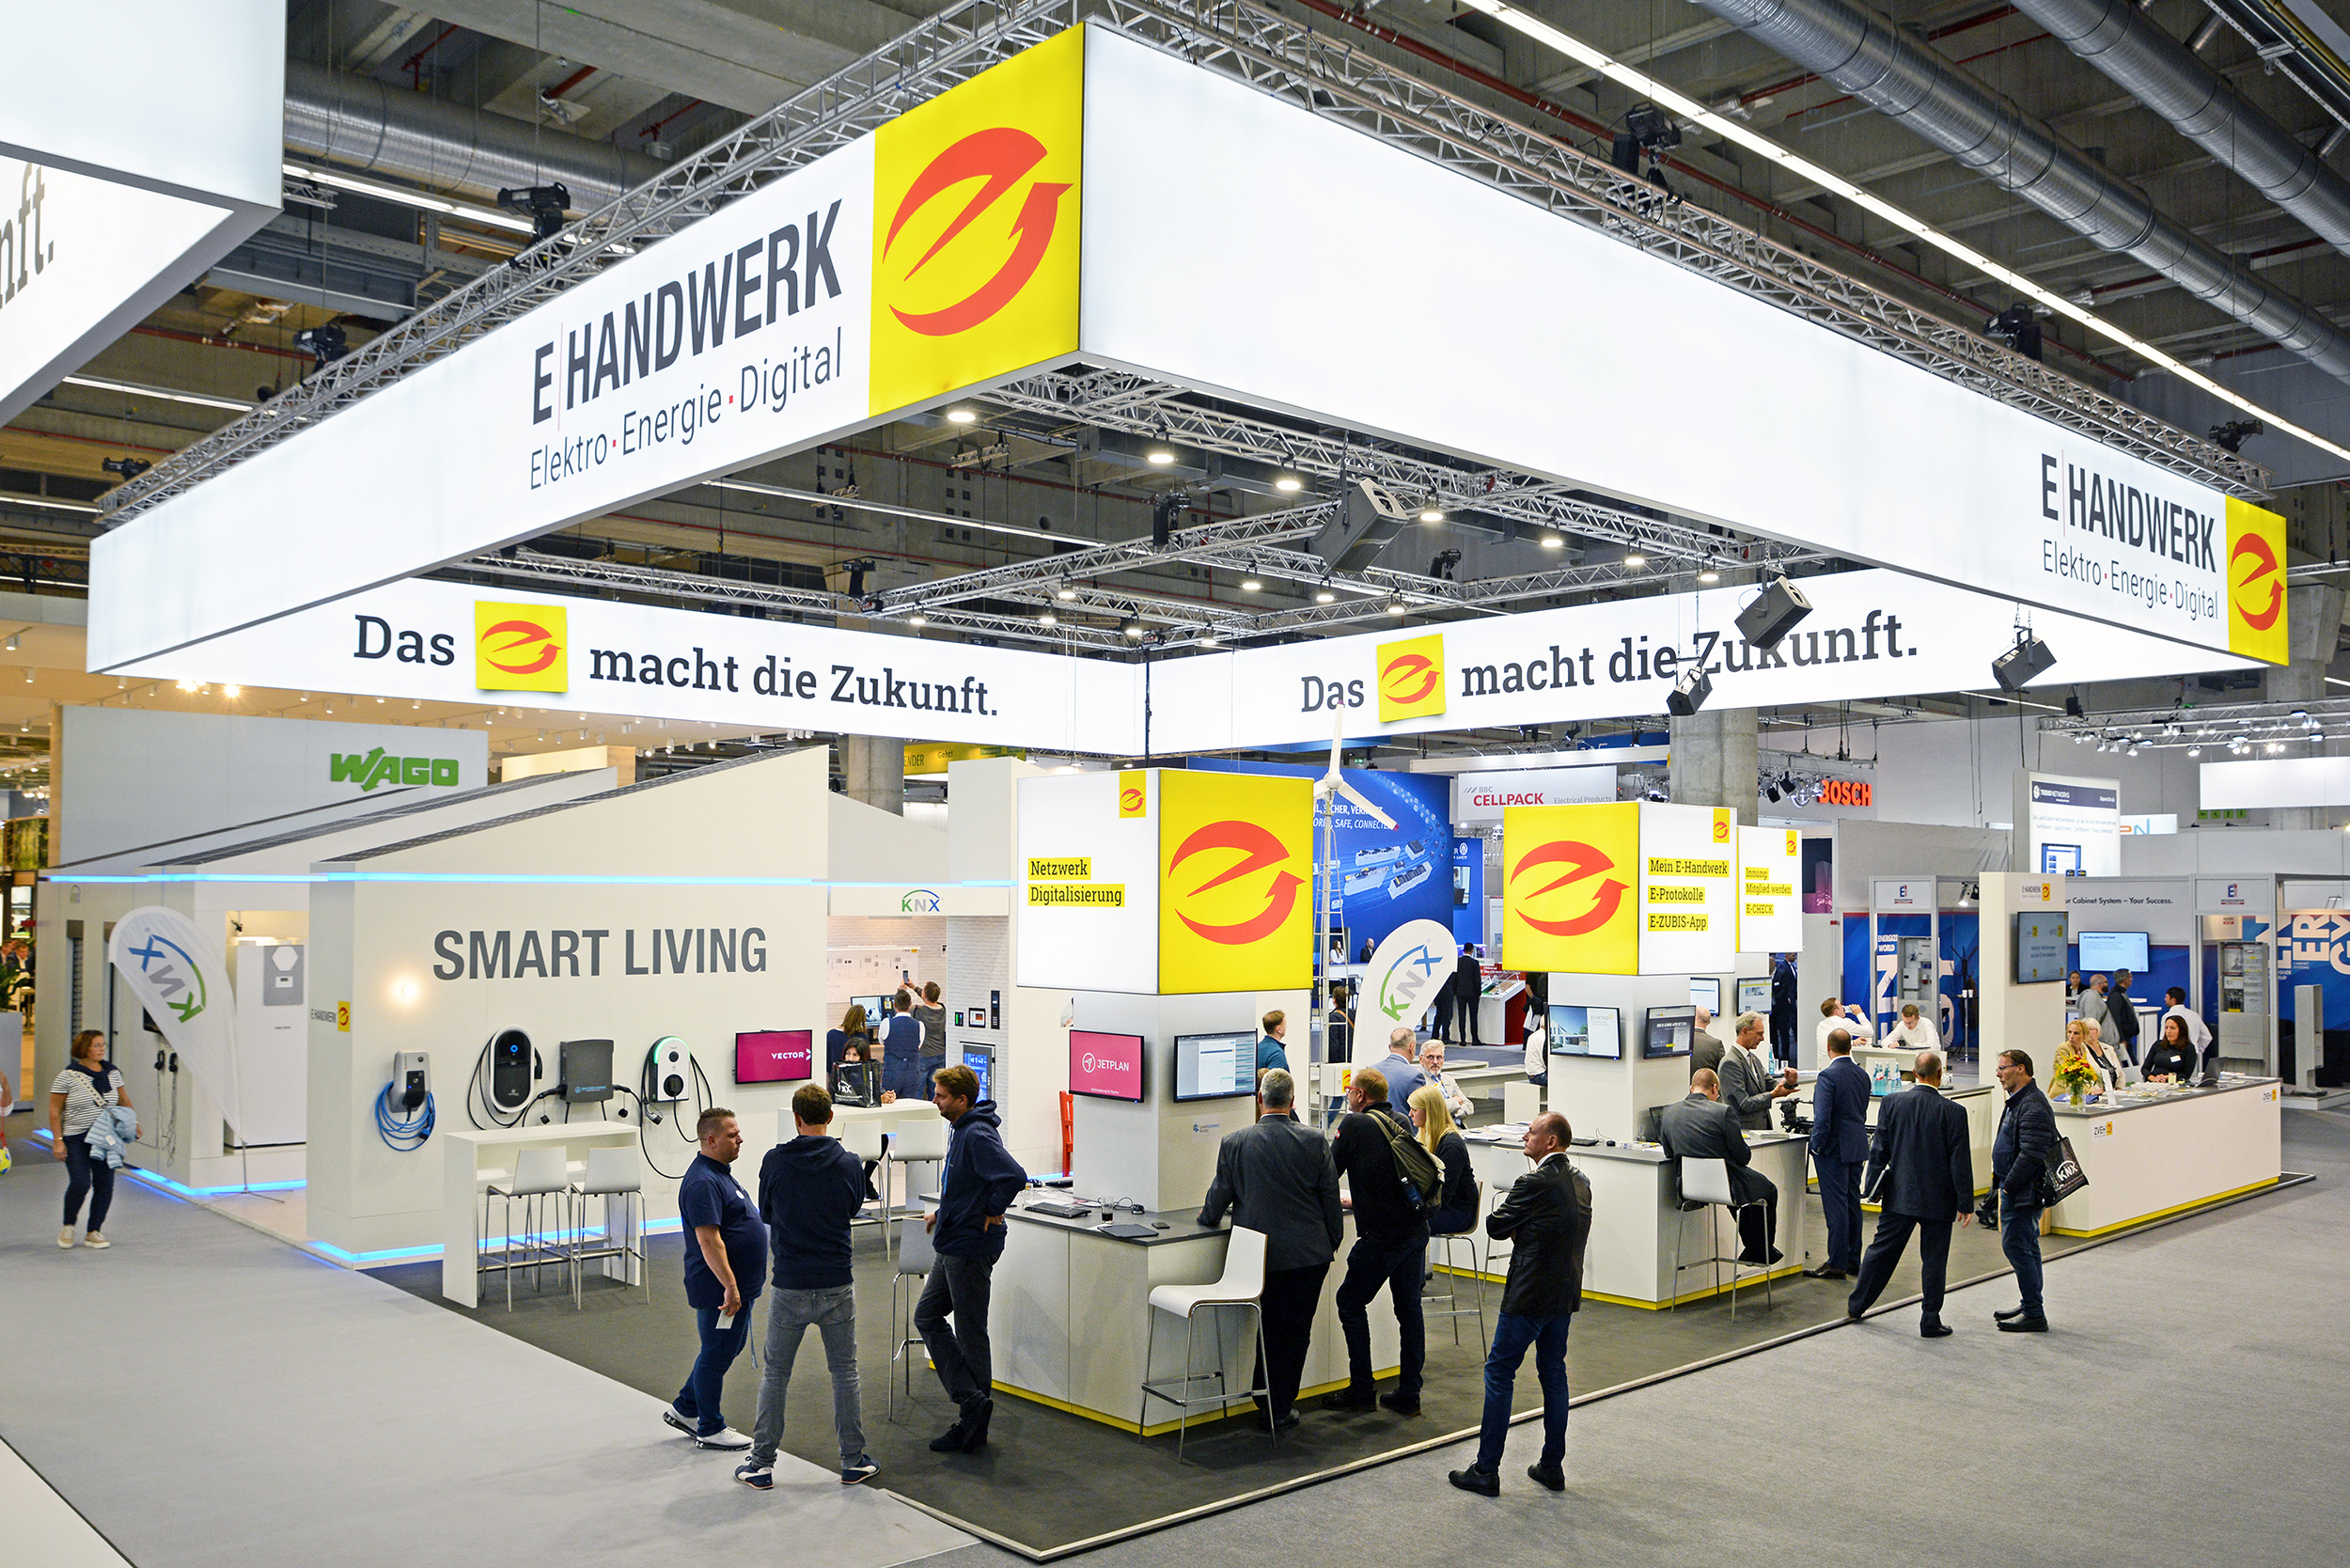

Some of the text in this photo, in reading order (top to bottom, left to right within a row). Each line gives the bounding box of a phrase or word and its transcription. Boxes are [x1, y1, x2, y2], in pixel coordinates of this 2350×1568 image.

[533, 198, 842, 425] E HANDWERK
[531, 326, 841, 490] Elektro Energie Digital
[2042, 454, 2217, 573] E HANDWERK
[2044, 540, 2218, 620] Elektro Energie Digital
[354, 615, 455, 666] Das
[589, 648, 738, 692] macht
[754, 655, 817, 698] die
[831, 665, 998, 715] Zukunft.
[1302, 675, 1365, 712] Das
[1462, 645, 1595, 697] macht
[1608, 635, 1678, 683] die
[1694, 610, 1918, 674] Zukunft.
[331, 747, 459, 792] WAGO
[1473, 792, 1544, 807] CELLPACK
[1554, 795, 1612, 805] Electrical Products
[1819, 779, 1872, 807] BOSCH
[1335, 818, 1353, 829] SAFE,
[1030, 859, 1089, 876] Netzwerk
[1650, 858, 1728, 875] Mein E-Handwerk
[1030, 886, 1122, 907] Digitalisierung
[1650, 886, 1703, 902] E-Protokolle
[1747, 883, 1792, 896] Mitglied werden
[901, 899, 940, 912] KNX
[1747, 903, 1774, 915] E-CHECK
[2098, 897, 2123, 905] System
[1650, 915, 1707, 932] E-ZUBIS-App
[433, 927, 767, 980] SMART LIVING
[1381, 944, 1444, 1022] KNX
[771, 1051, 805, 1059] VECTOR
[1097, 1058, 1130, 1072] JETPLAN
[2057, 1164, 2078, 1182] KNX
